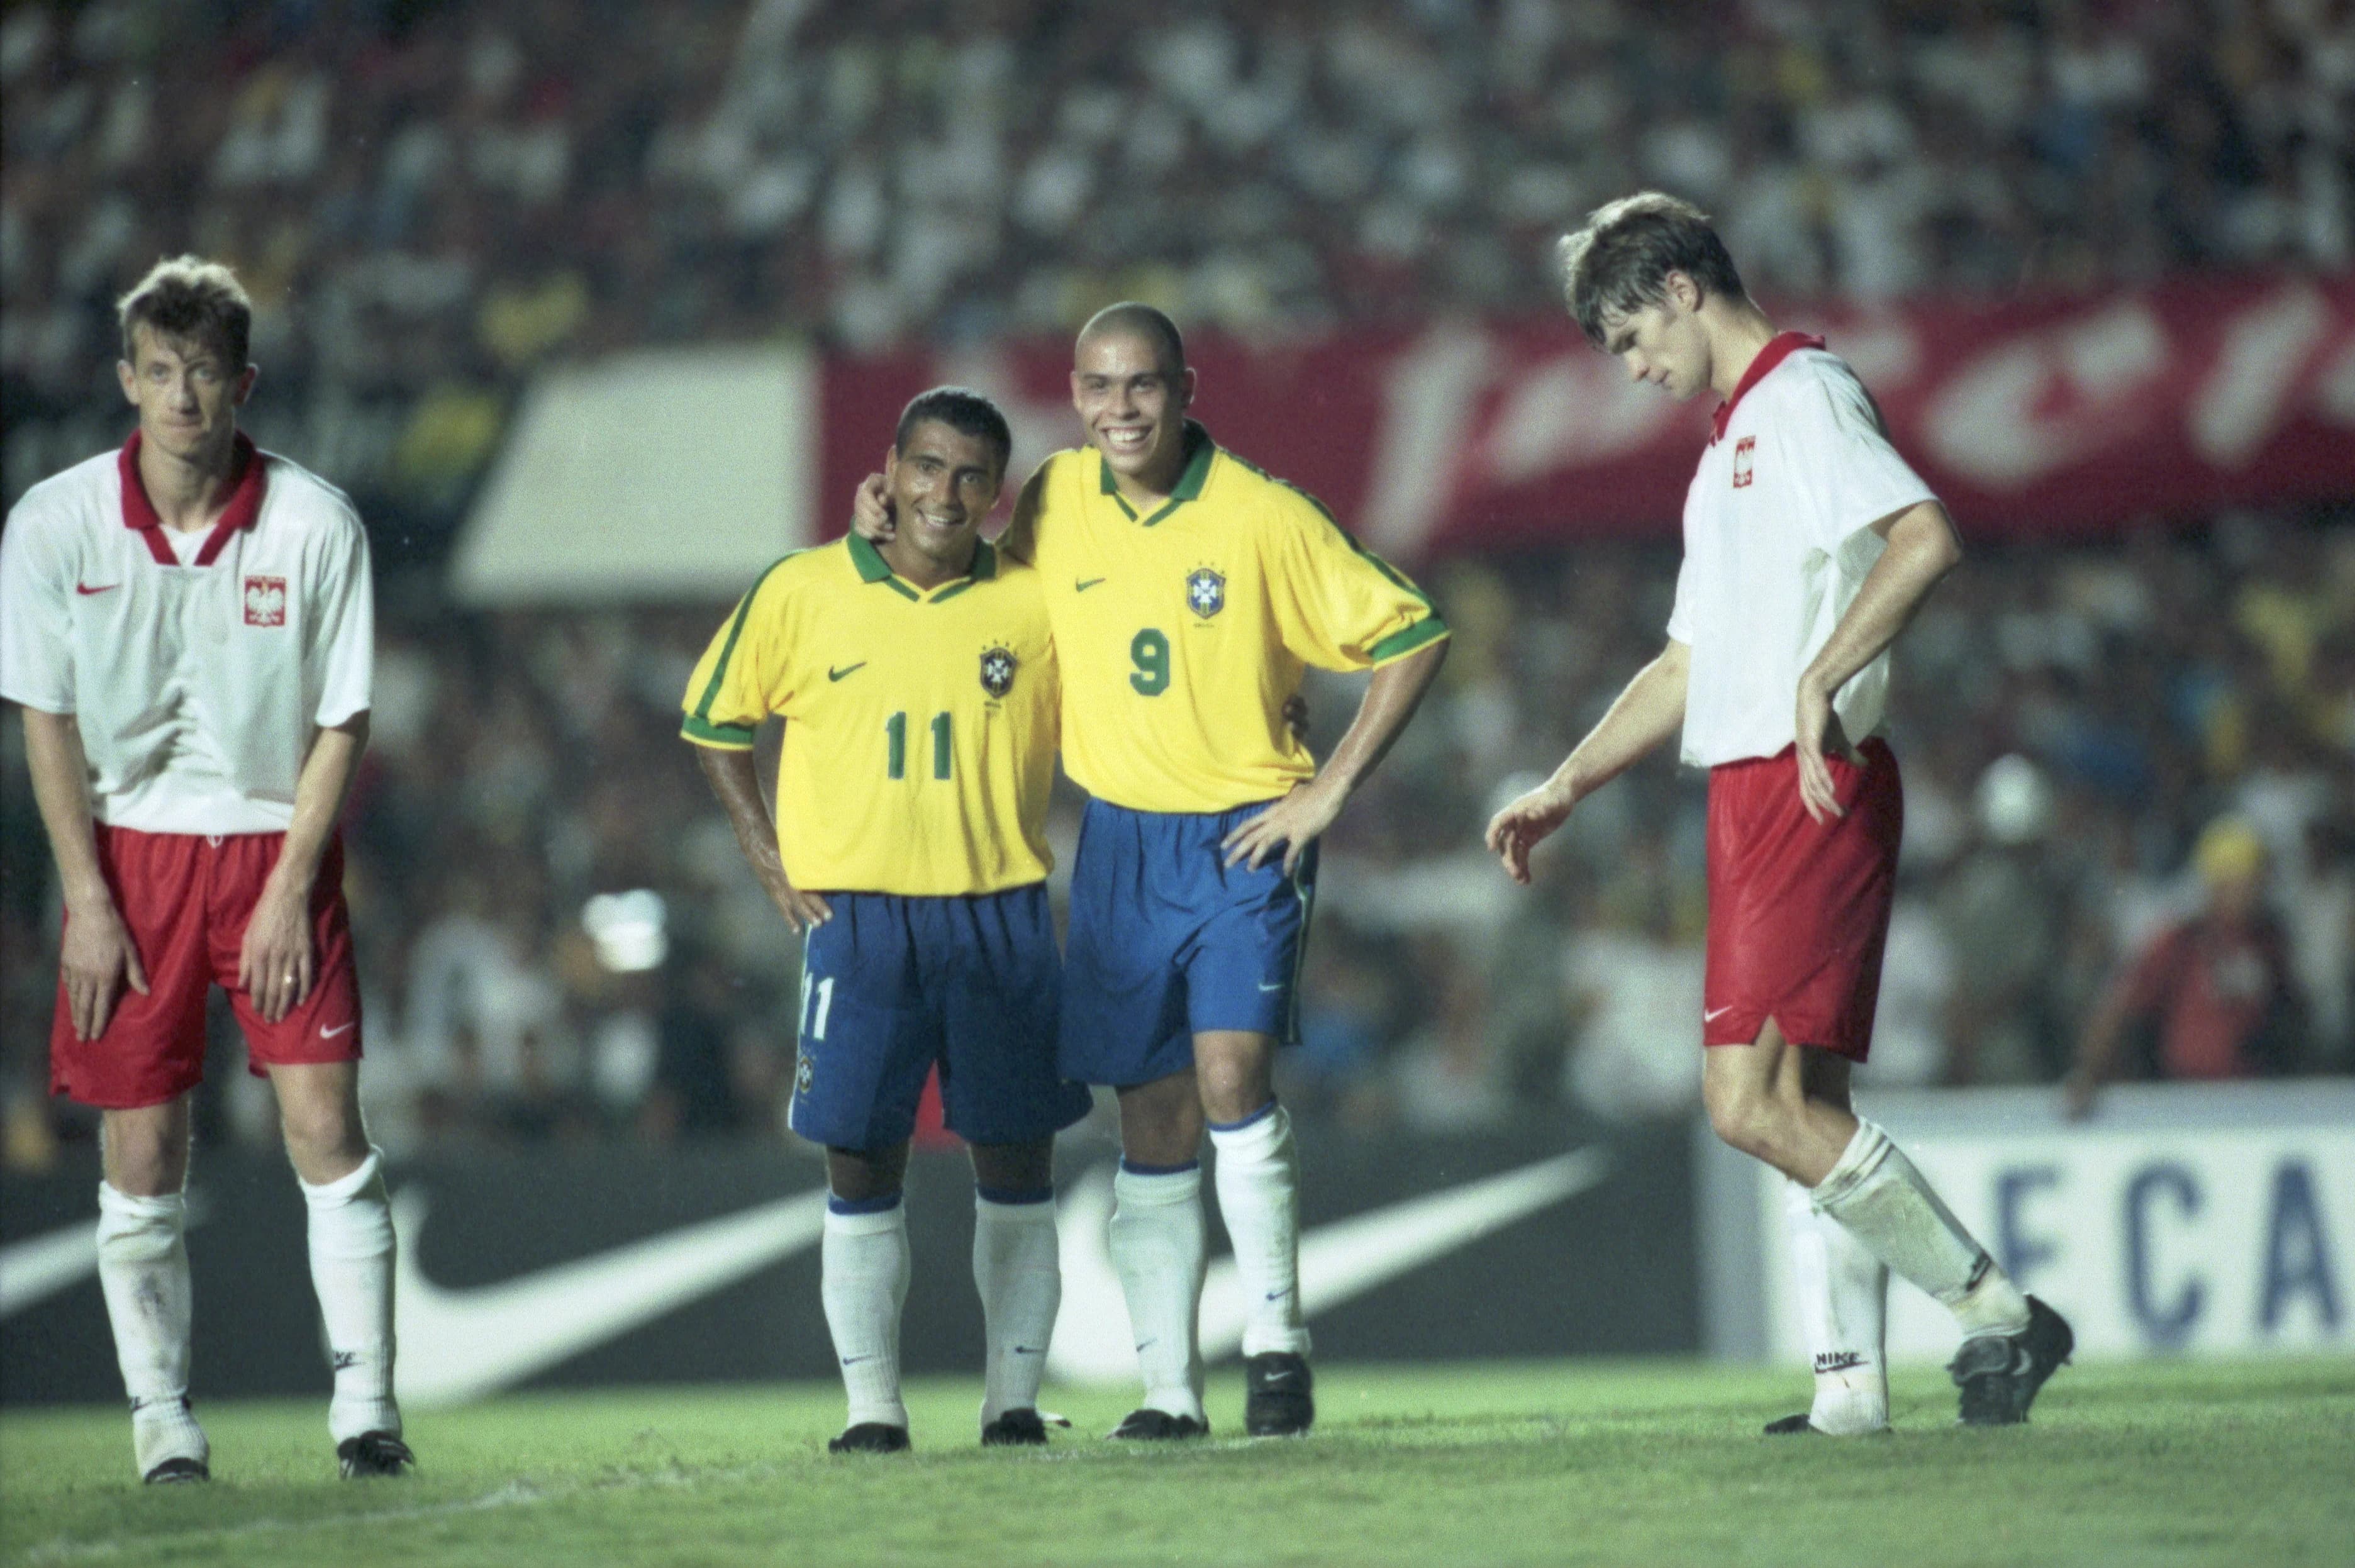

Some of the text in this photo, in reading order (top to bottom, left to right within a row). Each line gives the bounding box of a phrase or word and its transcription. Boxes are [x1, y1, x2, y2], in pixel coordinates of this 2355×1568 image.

[1130, 628, 1170, 696] 9
[886, 711, 952, 780] 11
[1815, 1352, 1860, 1365] NIKE
